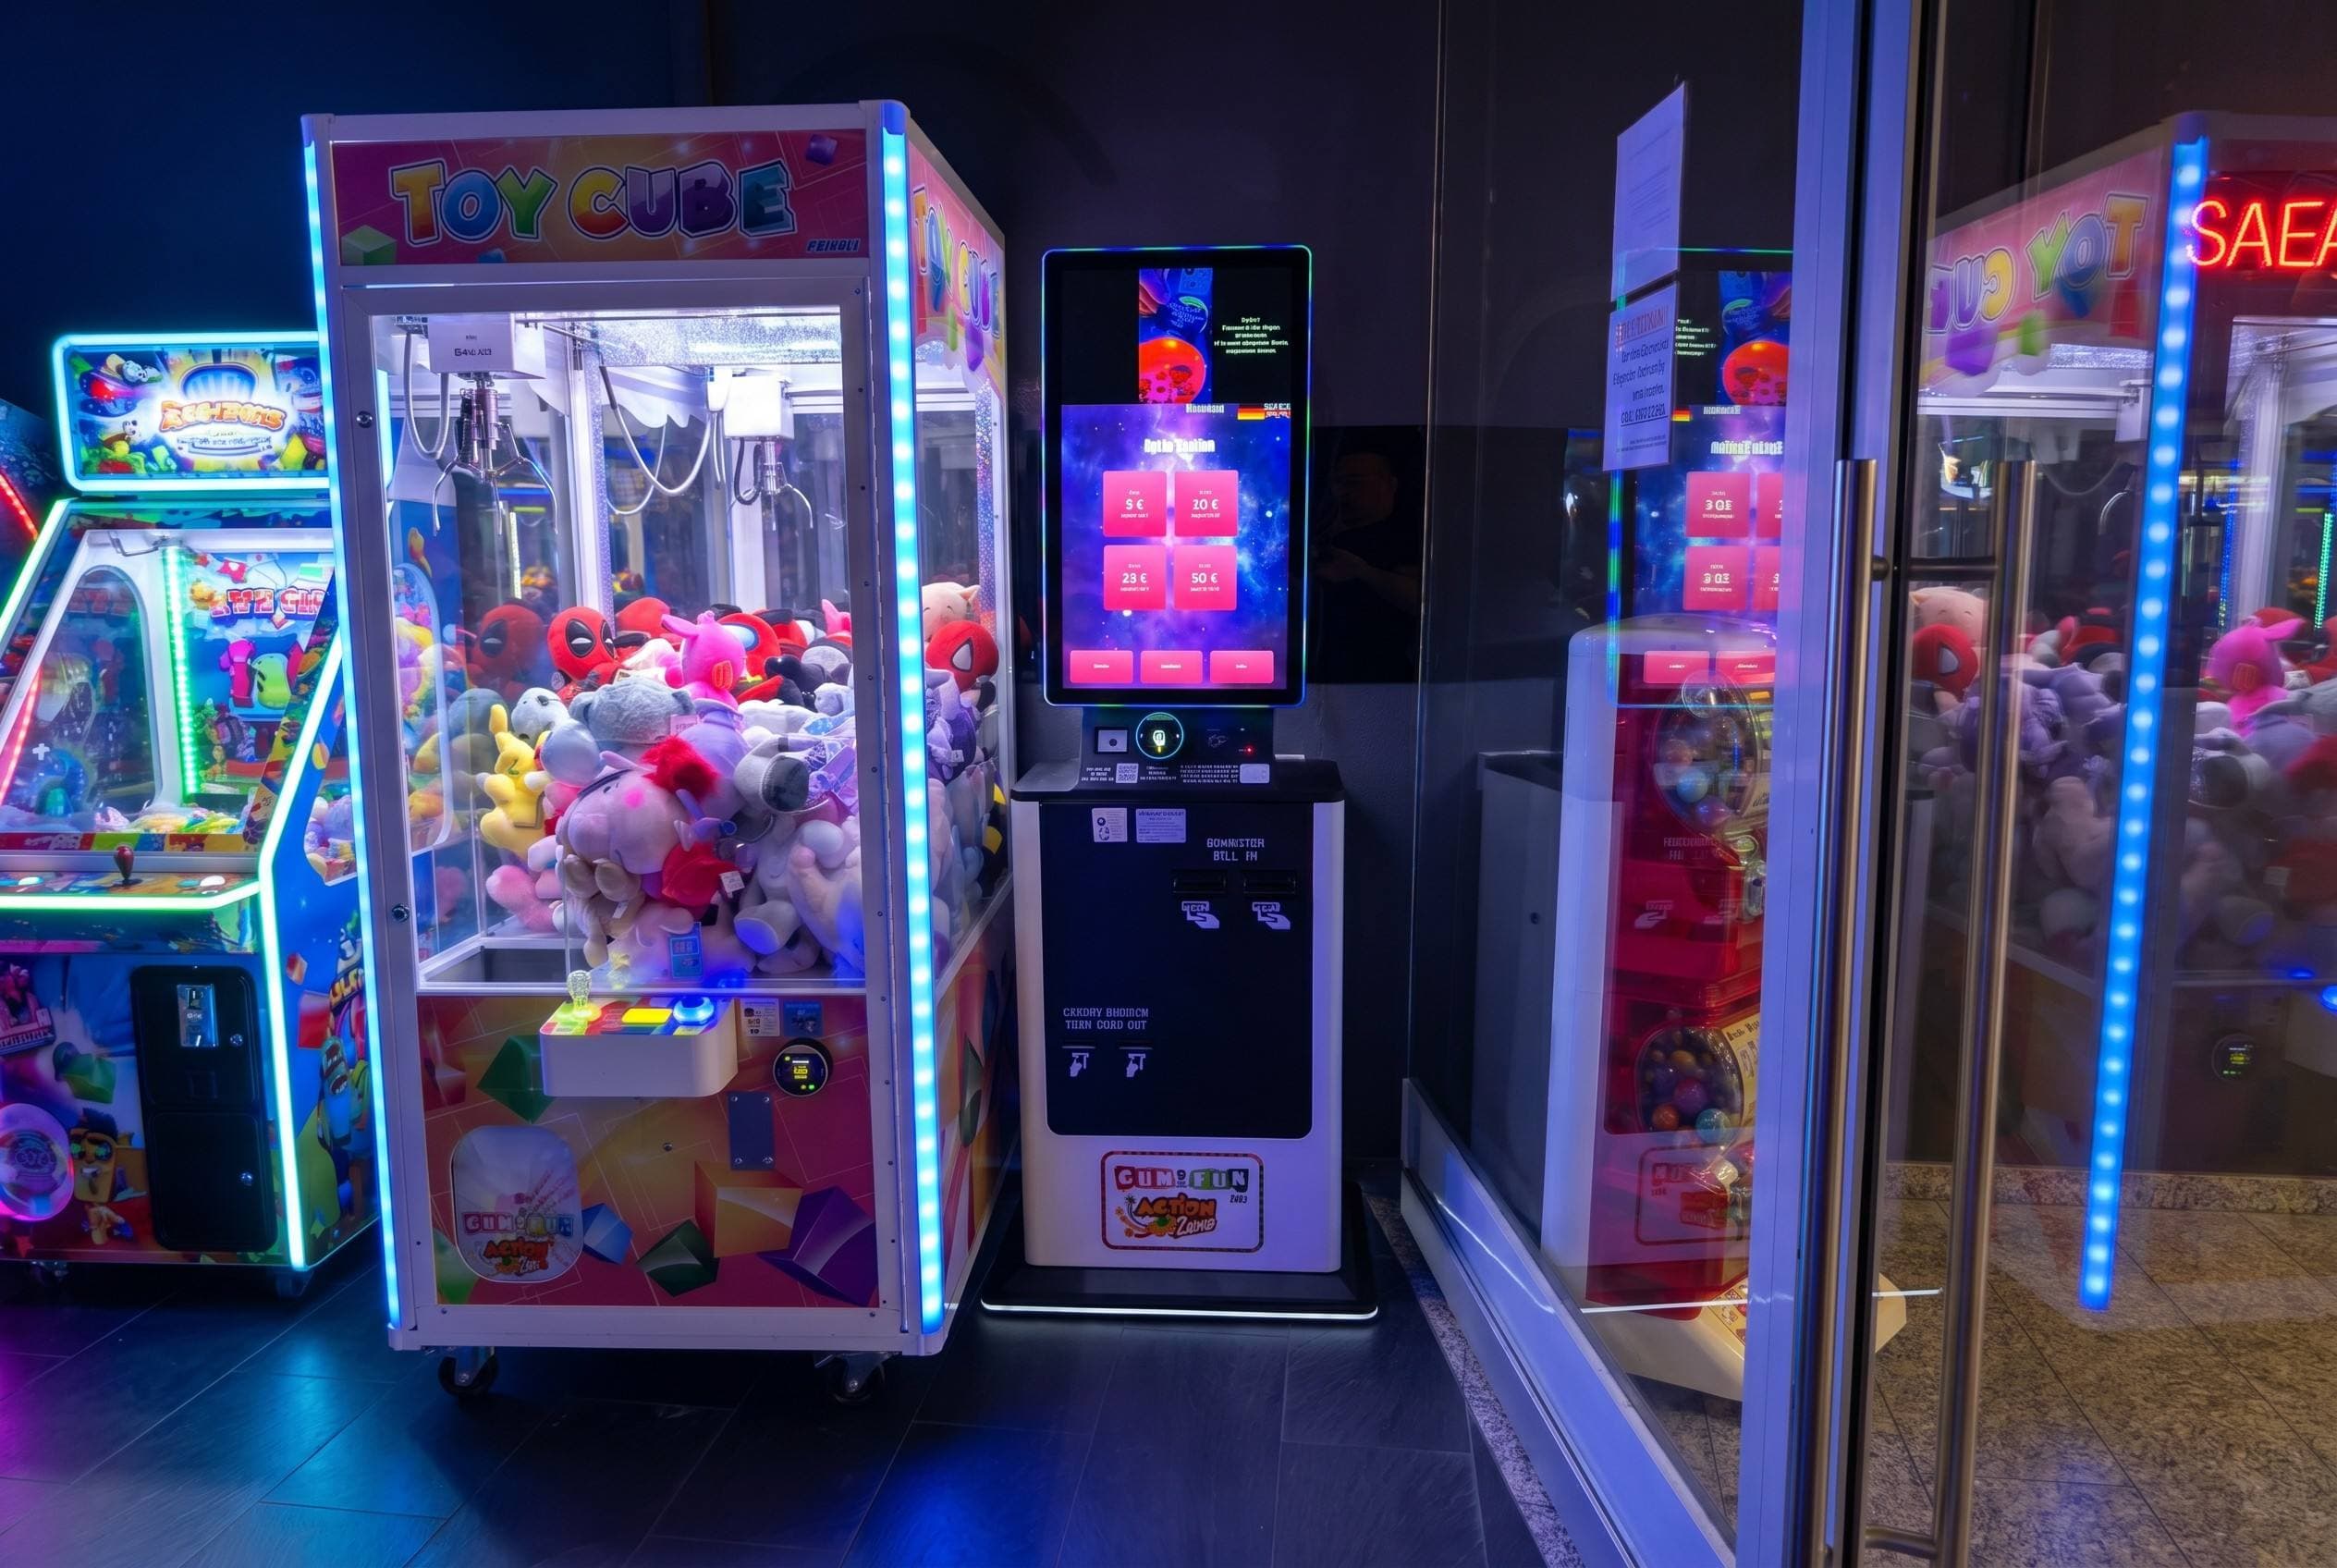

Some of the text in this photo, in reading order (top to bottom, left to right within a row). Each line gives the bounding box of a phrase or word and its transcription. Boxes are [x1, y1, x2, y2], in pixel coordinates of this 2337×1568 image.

[389, 159, 797, 246] TOY CUBE
[912, 186, 954, 300] TOY
[1211, 498, 1220, 510] €
[1191, 572, 1219, 584] 50 €
[1127, 1020, 1147, 1030] OUT
[1115, 1167, 1175, 1189] GUM
[1190, 1169, 1248, 1190] FUN
[1135, 1194, 1217, 1216] ACTION
